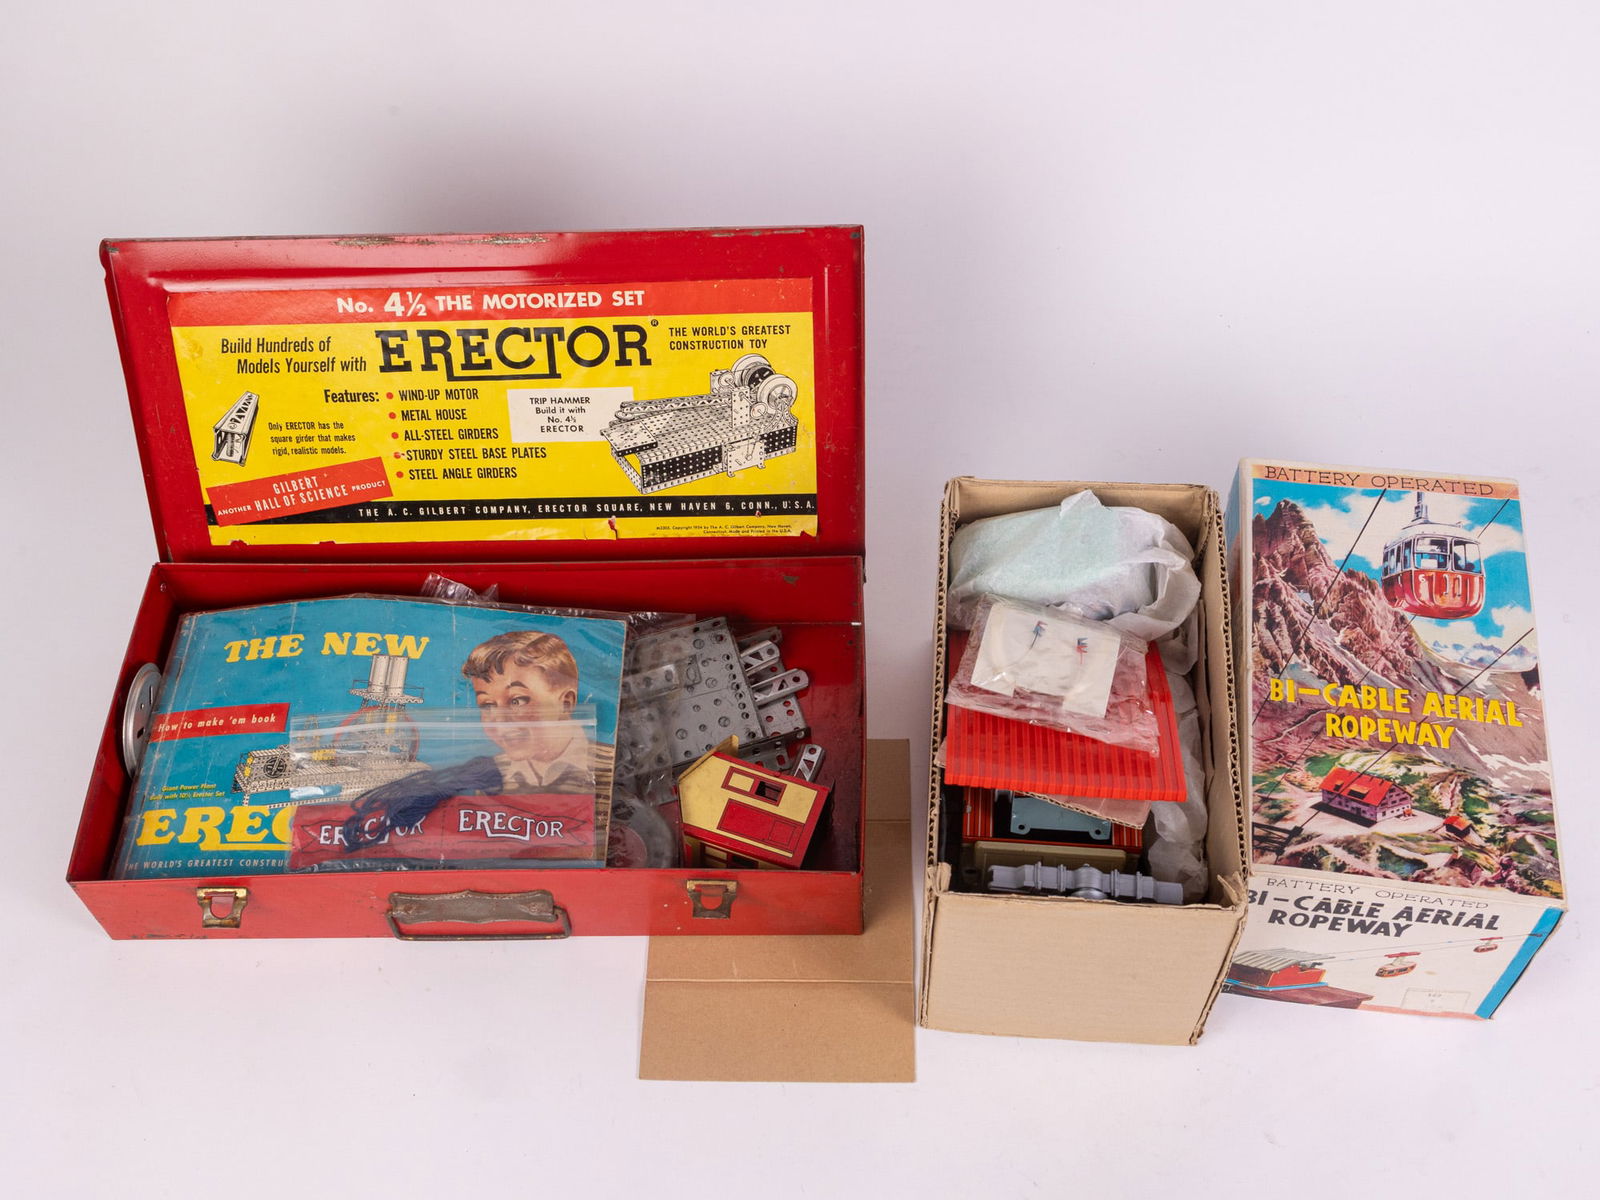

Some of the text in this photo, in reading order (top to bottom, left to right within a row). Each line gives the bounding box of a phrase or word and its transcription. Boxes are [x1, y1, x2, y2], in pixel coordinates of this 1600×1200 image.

[336, 298, 374, 313] No.
[435, 296, 472, 311] THE
[482, 292, 602, 310] MOTORIZED
[612, 290, 645, 306] SET
[669, 324, 790, 337] THE WORLD'S GREATEST
[221, 336, 332, 354] Build Hundreds of
[374, 324, 652, 381] ERECTOR
[670, 338, 768, 350] CONSTRUCTION TOY
[237, 357, 367, 374] Models Yourself with
[324, 389, 380, 404] Features:
[399, 388, 478, 401] WIND-UP MOTOR
[530, 396, 590, 406] TRIP HAMMER
[402, 408, 467, 421] METAL HOUSE
[536, 406, 556, 414] Build
[268, 421, 344, 432] Only ERECTOR has the
[404, 428, 499, 441] ALL-STEEL GIRDERS
[540, 425, 584, 433] ERECTOR
[270, 434, 356, 444] square girder that makes
[272, 446, 346, 456] rigid, realistic models.
[406, 448, 546, 461] STURDY STEEL BASE PLATES
[409, 467, 517, 480] STEEL ANGLE GIRDERS
[1264, 465, 1494, 496] BATTERY OPERATED
[272, 475, 319, 494] GILBERT
[218, 480, 386, 516] ANOTHER HALL OF SCIENCE PRODUCT
[359, 508, 380, 517] THE
[388, 508, 397, 516] A.
[403, 508, 412, 516] C.
[419, 506, 466, 516] GILBERT
[475, 505, 531, 514] COMPANY,
[538, 504, 588, 513] ERECTOR
[596, 503, 643, 512] SQUARE,
[650, 502, 672, 510] NEW
[681, 502, 716, 510] HAVEN
[741, 501, 778, 510] CONN.,
[782, 500, 815, 510] U.S.A.
[224, 632, 430, 663] THE NEW
[1423, 691, 1524, 728] AERIAL
[158, 713, 276, 732] How to make 'em book
[1325, 713, 1456, 749] ROPEWAY
[458, 809, 564, 840] ERECTOR
[143, 860, 182, 869] WORLD'S
[187, 859, 234, 868] GREATEST
[1266, 878, 1489, 910] BATTERY OPERATED
[1268, 910, 1413, 938] ROPEWAY
[1391, 906, 1500, 930] AERIAL
